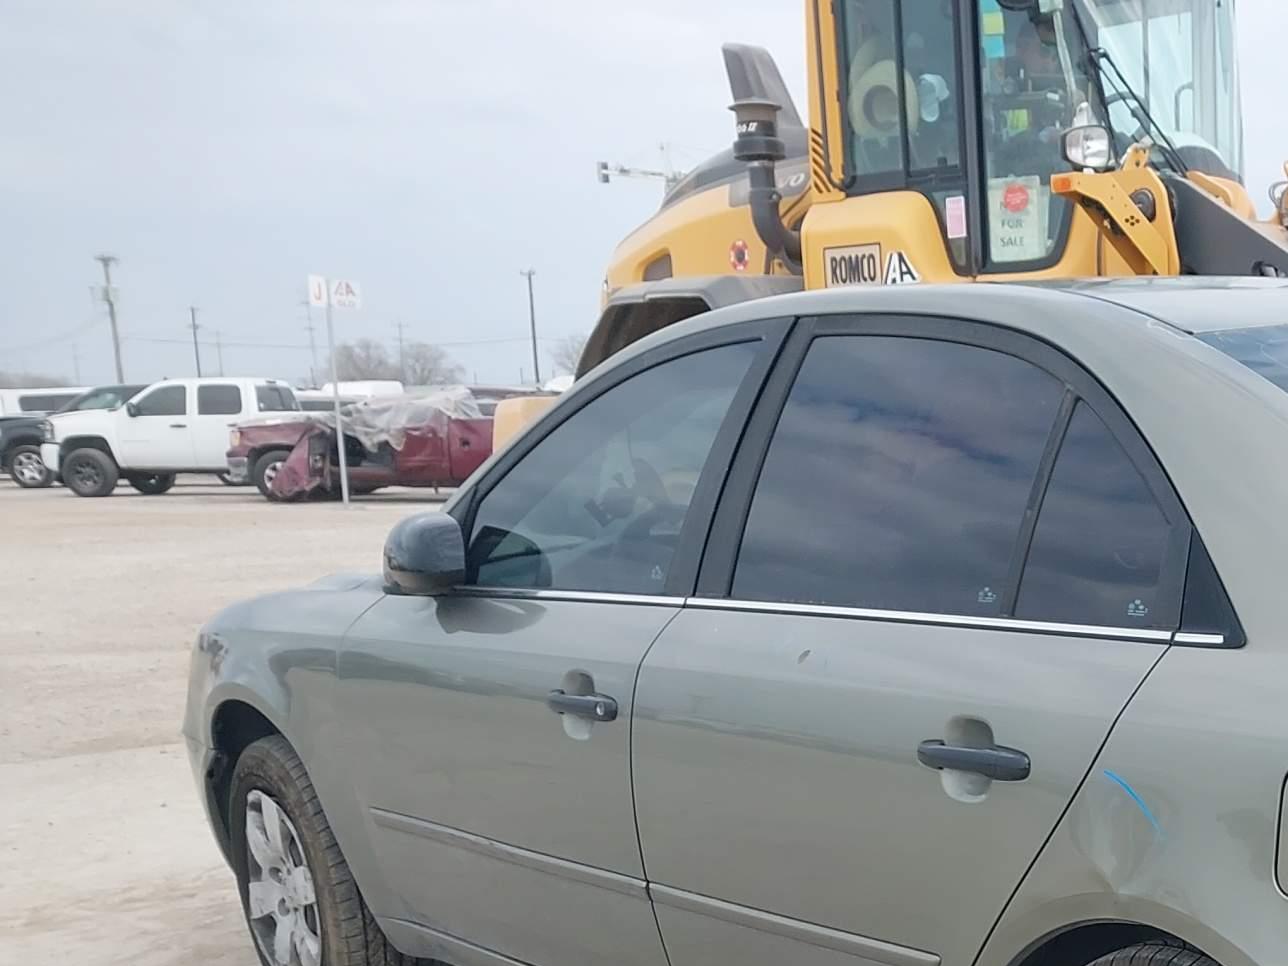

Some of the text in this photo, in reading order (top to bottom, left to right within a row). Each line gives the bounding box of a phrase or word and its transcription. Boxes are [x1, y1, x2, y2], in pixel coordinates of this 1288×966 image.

[1001, 219, 1024, 230] FOR
[1000, 236, 1025, 249] SALE
[830, 253, 876, 284] ROMCO
